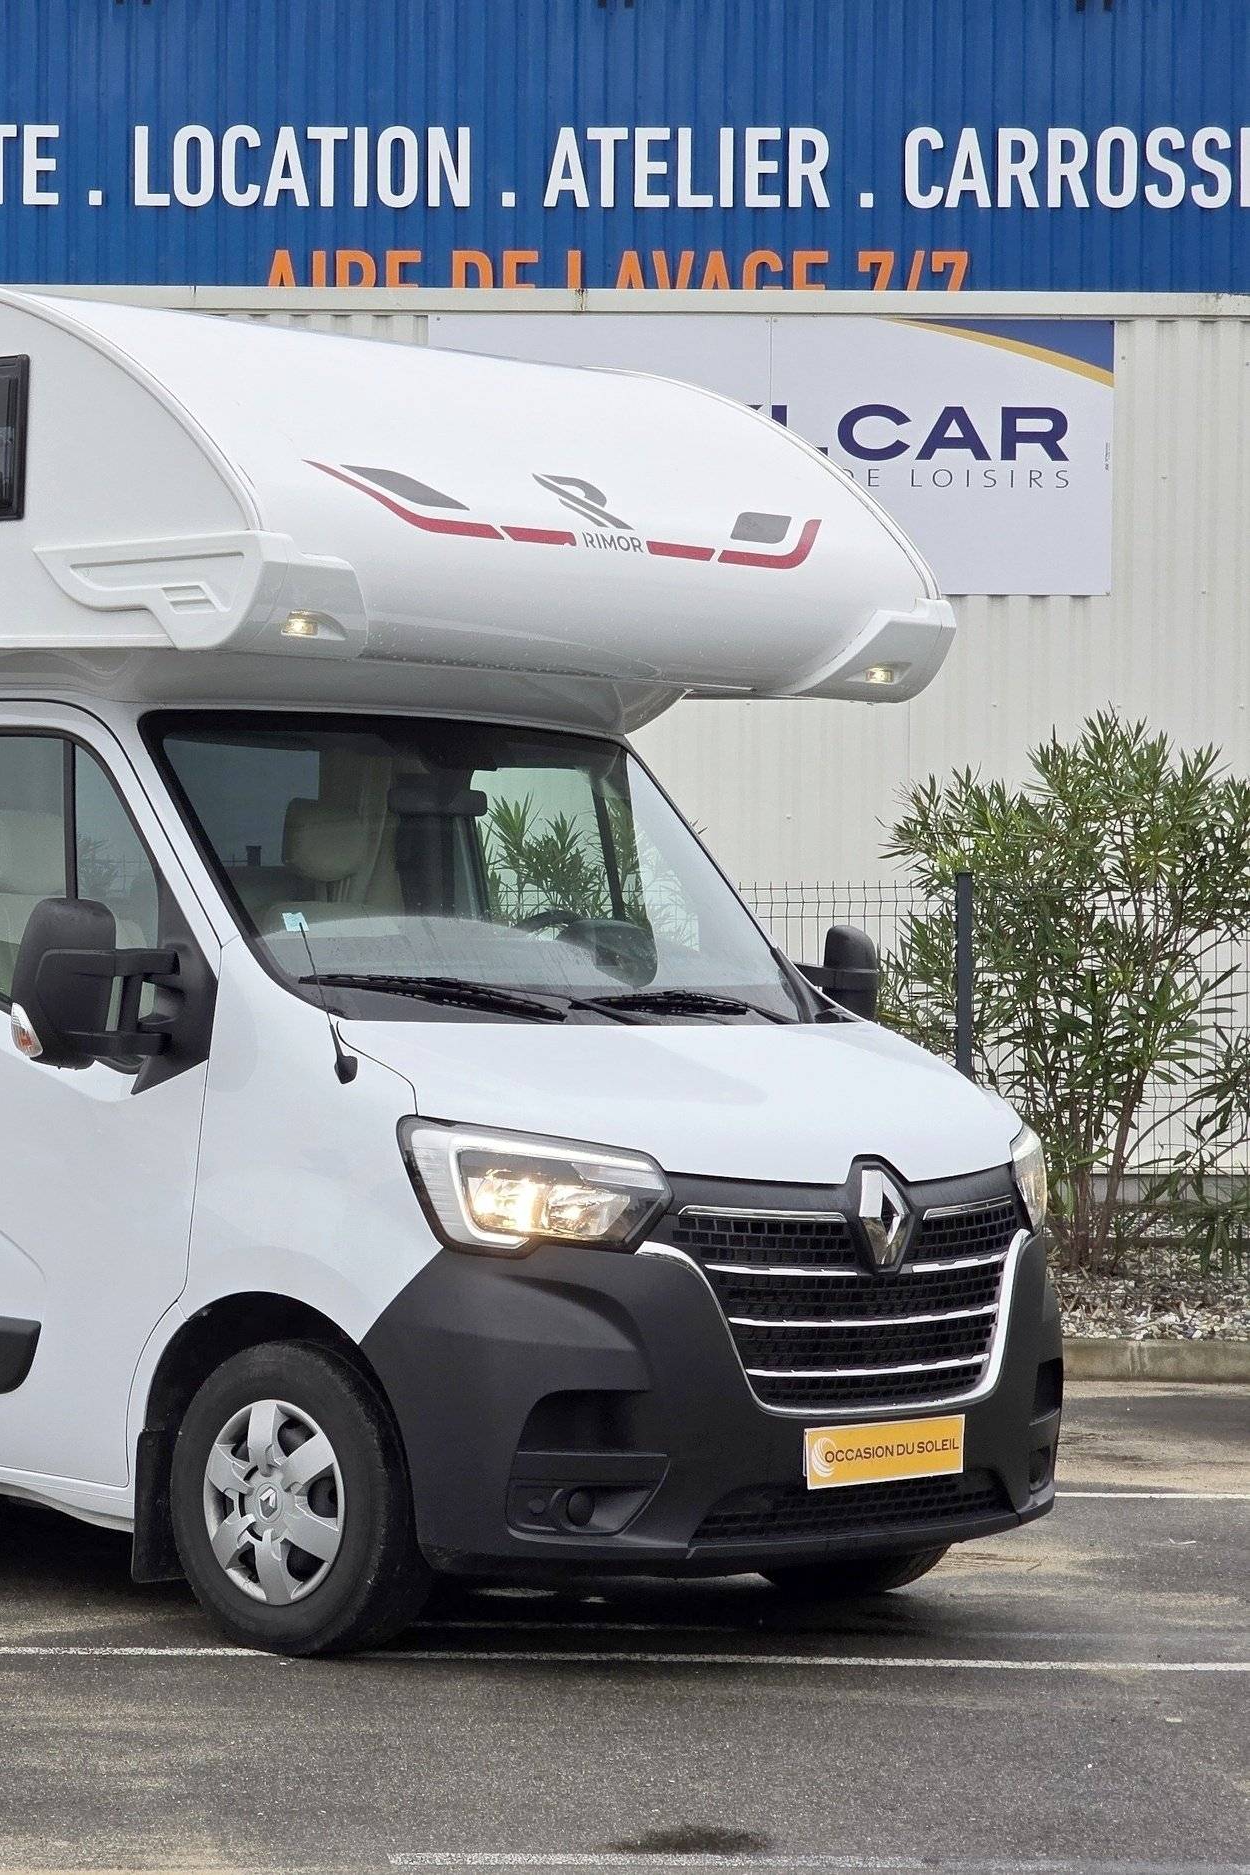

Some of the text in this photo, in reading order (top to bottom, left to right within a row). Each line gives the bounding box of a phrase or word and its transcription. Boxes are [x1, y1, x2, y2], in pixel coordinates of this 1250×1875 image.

[134, 124, 471, 208] LOCATION
[543, 127, 831, 208] ATELIER
[904, 126, 1250, 208] CARROSS
[910, 469, 1069, 489] LOISIRS
[582, 532, 644, 553] RIMOR
[824, 1438, 959, 1463] OCCASION DU SOLEIL
